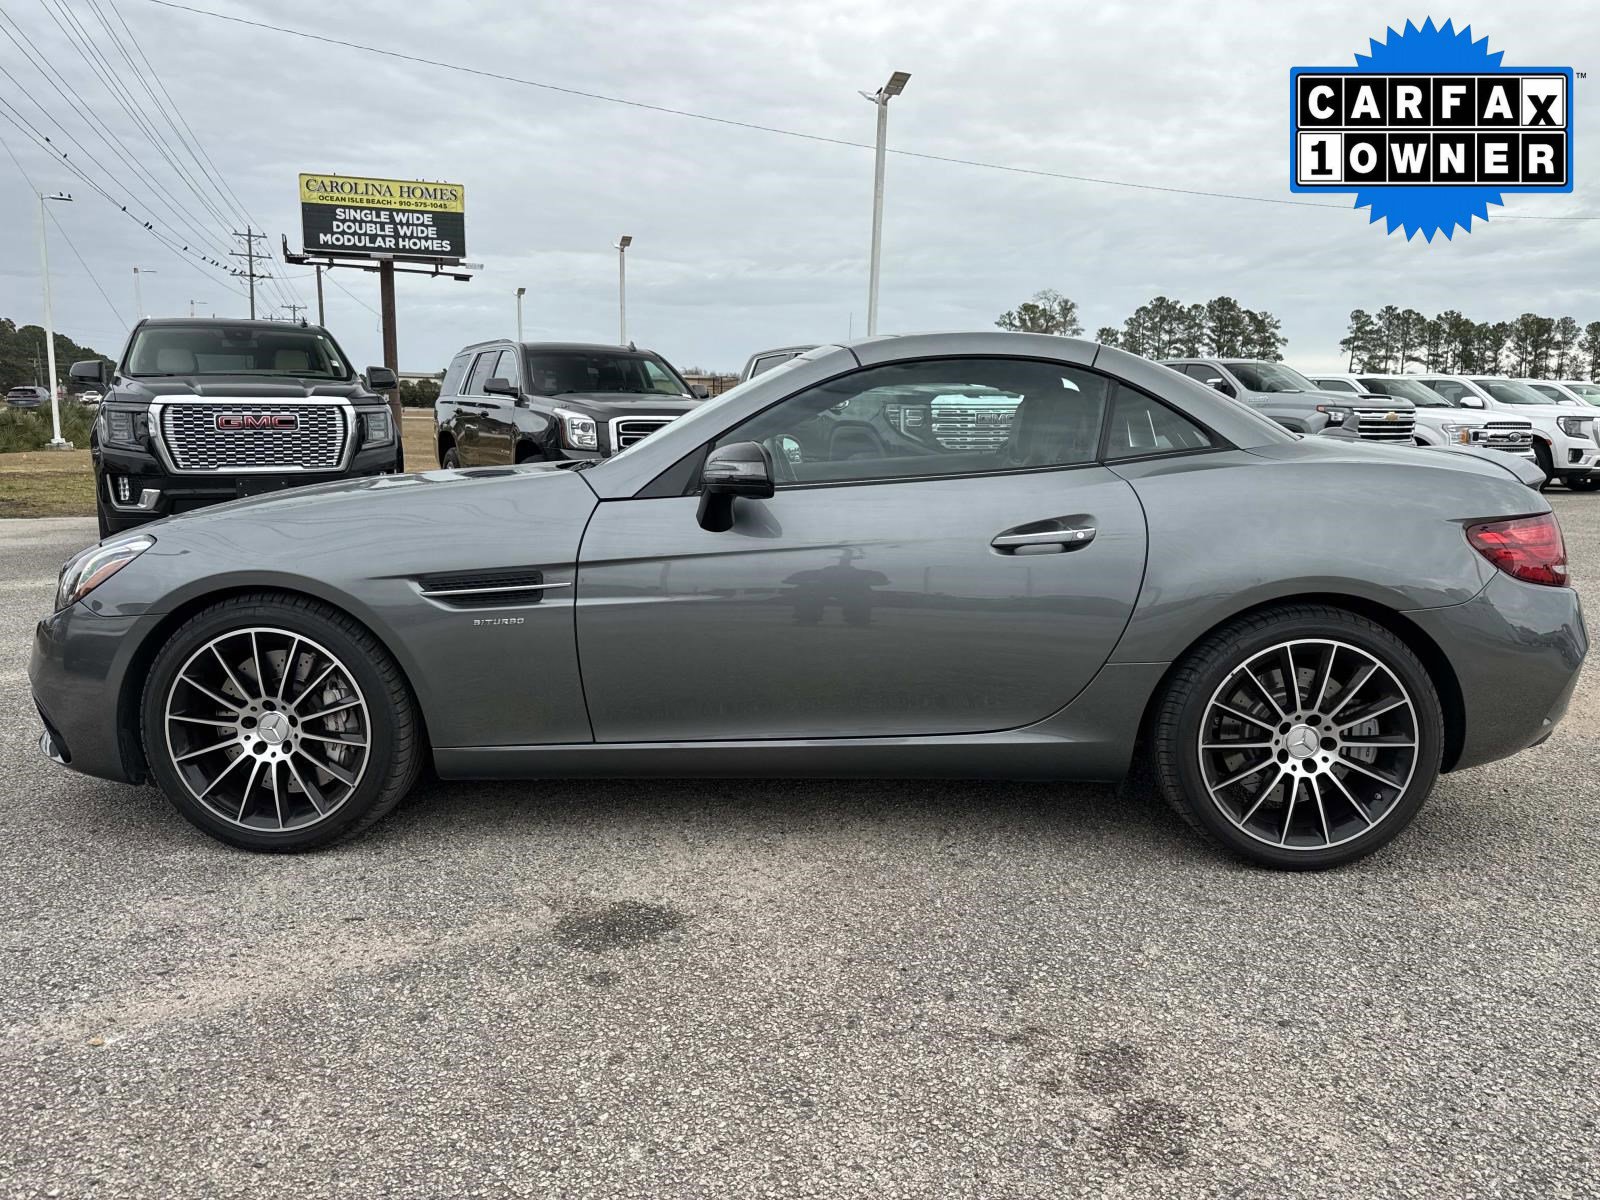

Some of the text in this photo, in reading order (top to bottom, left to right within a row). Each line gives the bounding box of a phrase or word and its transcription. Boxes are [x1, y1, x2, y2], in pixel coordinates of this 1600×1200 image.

[305, 178, 458, 202] CAROLINA HOMES
[318, 195, 347, 203] OCEAN
[366, 198, 392, 206] BEACH
[398, 200, 448, 209] 910-575-1045
[335, 208, 433, 225] SINGLE WIDE
[332, 221, 438, 238] DOUBLE WIDE
[319, 233, 451, 252] MODULAR HOMES
[218, 415, 296, 429] GMC
[472, 617, 525, 626] BITURBO
